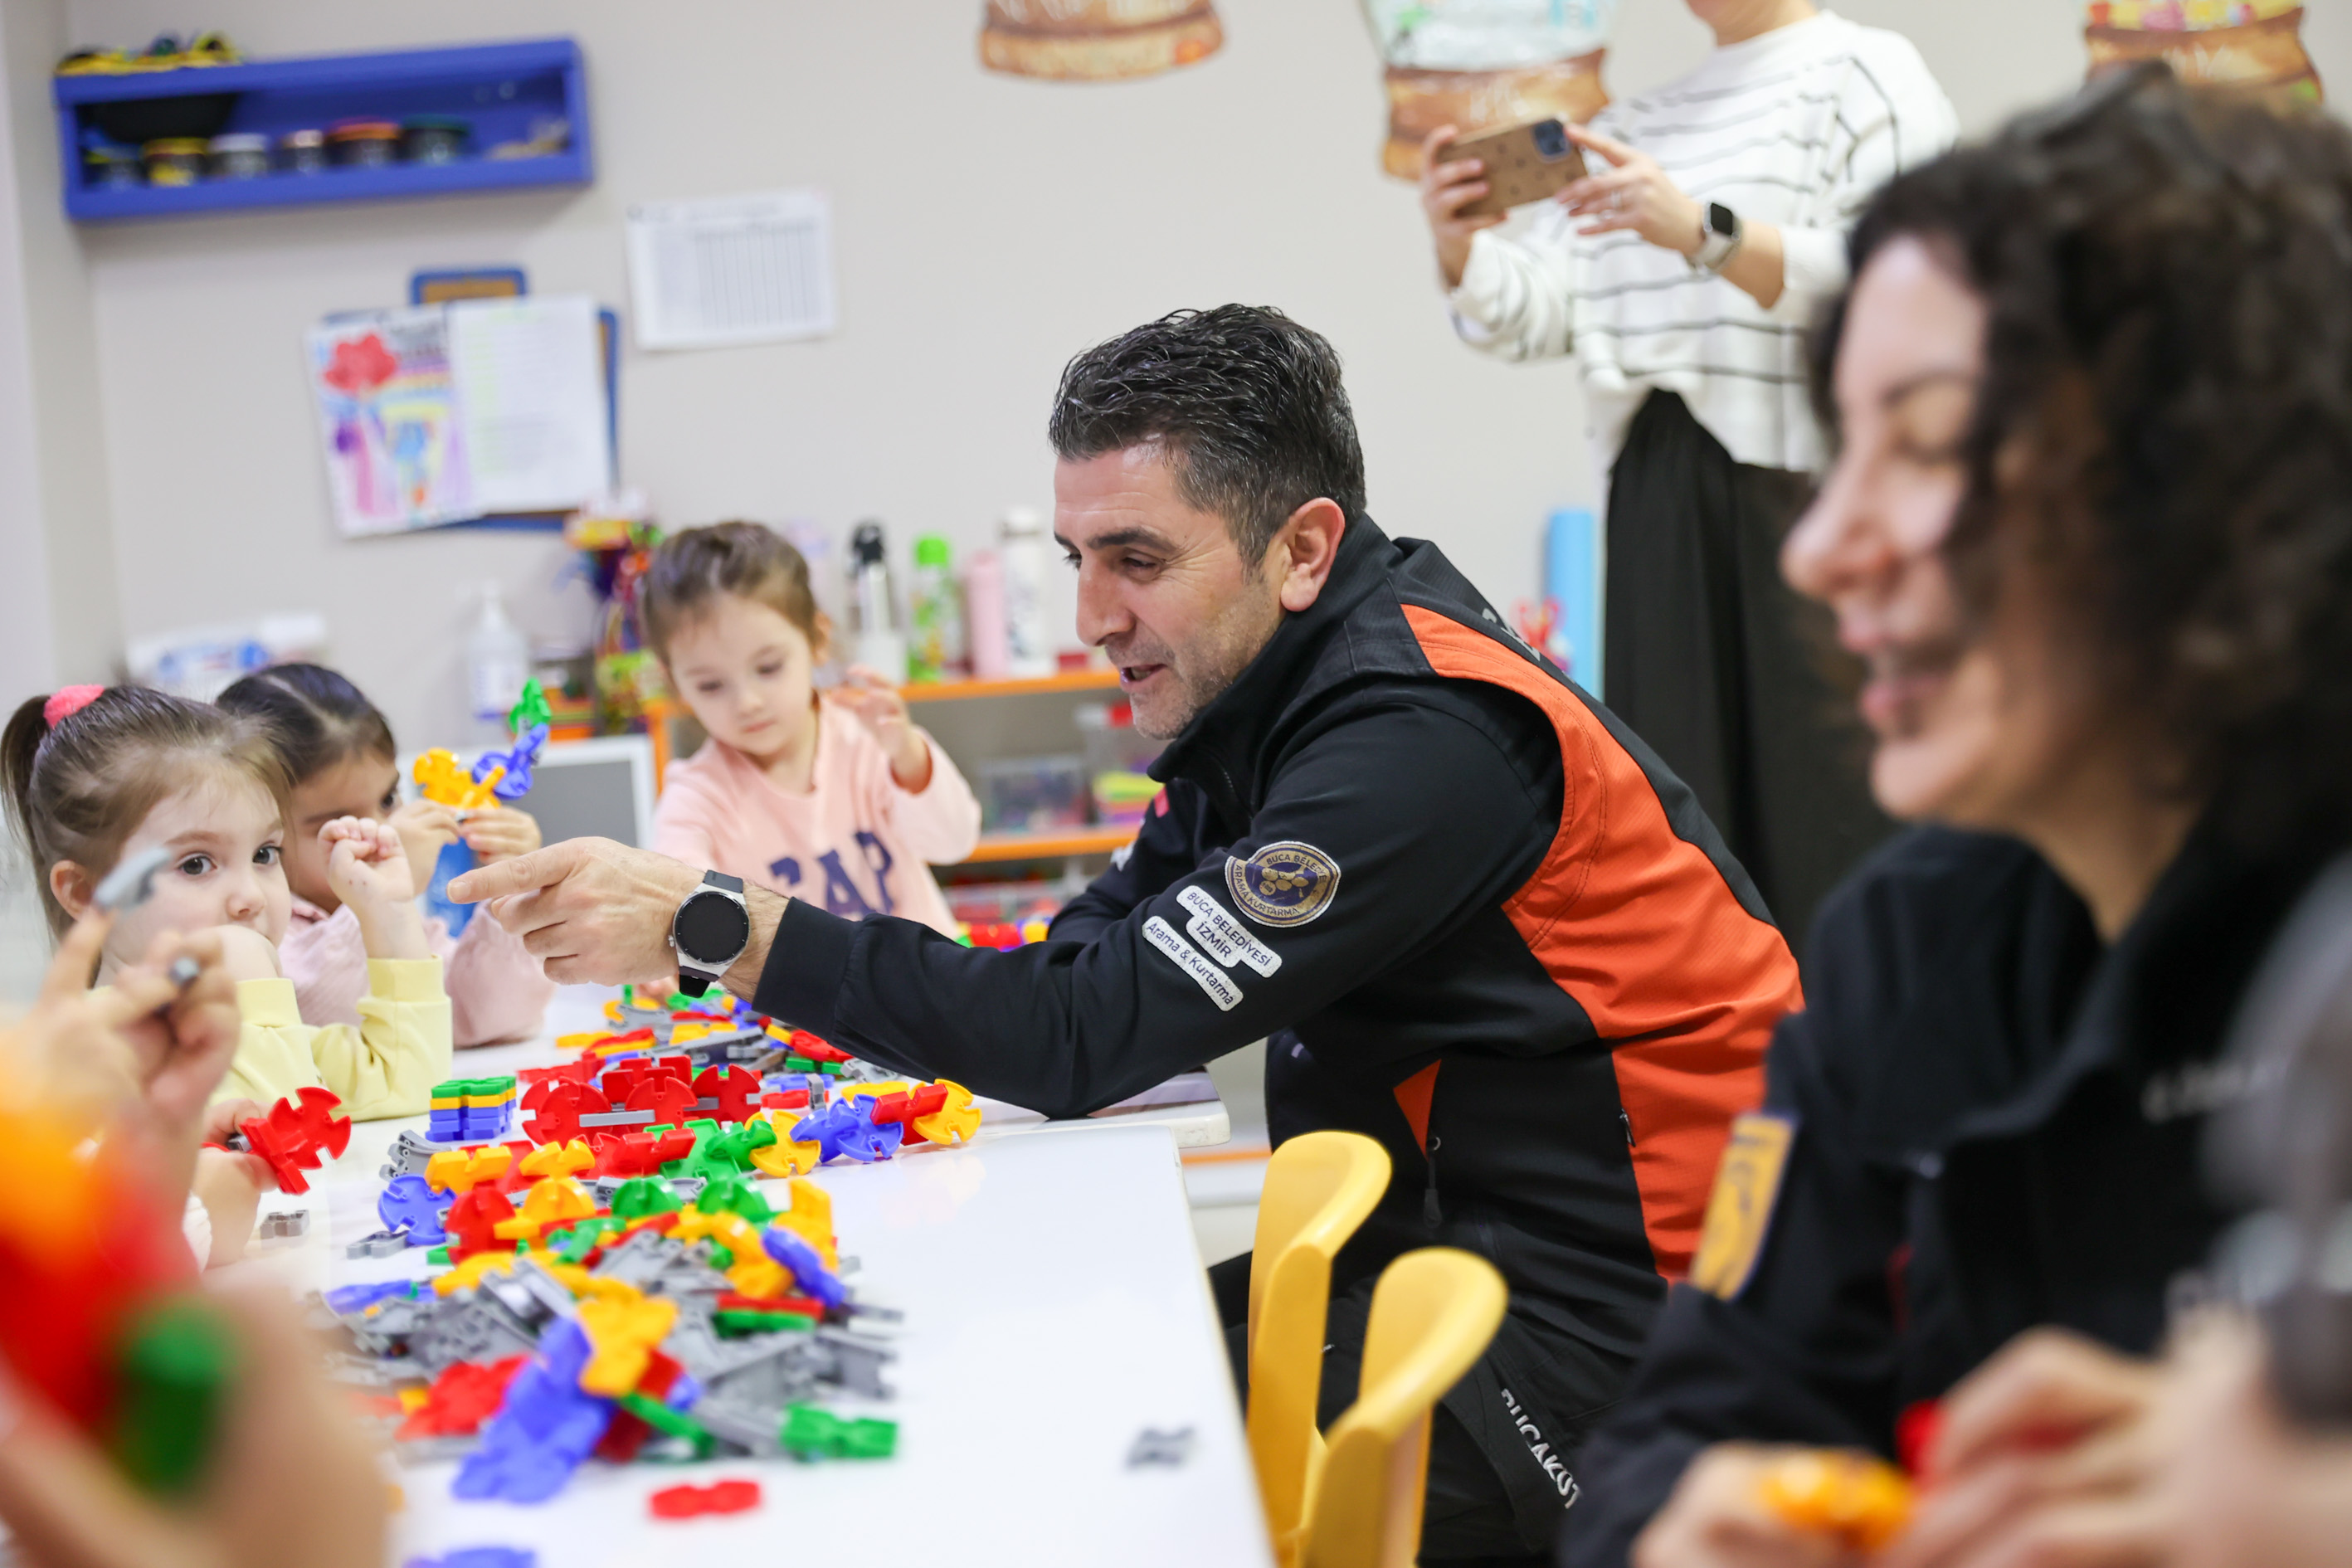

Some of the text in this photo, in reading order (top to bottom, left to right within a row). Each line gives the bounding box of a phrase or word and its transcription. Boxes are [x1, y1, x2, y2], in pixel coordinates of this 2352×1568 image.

[1266, 854, 1291, 864] BUCA
[1234, 864, 1249, 899] ARAMA
[1248, 896, 1300, 917] KURTARMA
[1187, 892, 1273, 967] BUCA BELEDİYESİ
[1195, 921, 1232, 958] İZMİR
[1147, 923, 1234, 1006] Arama & Kurtarma
